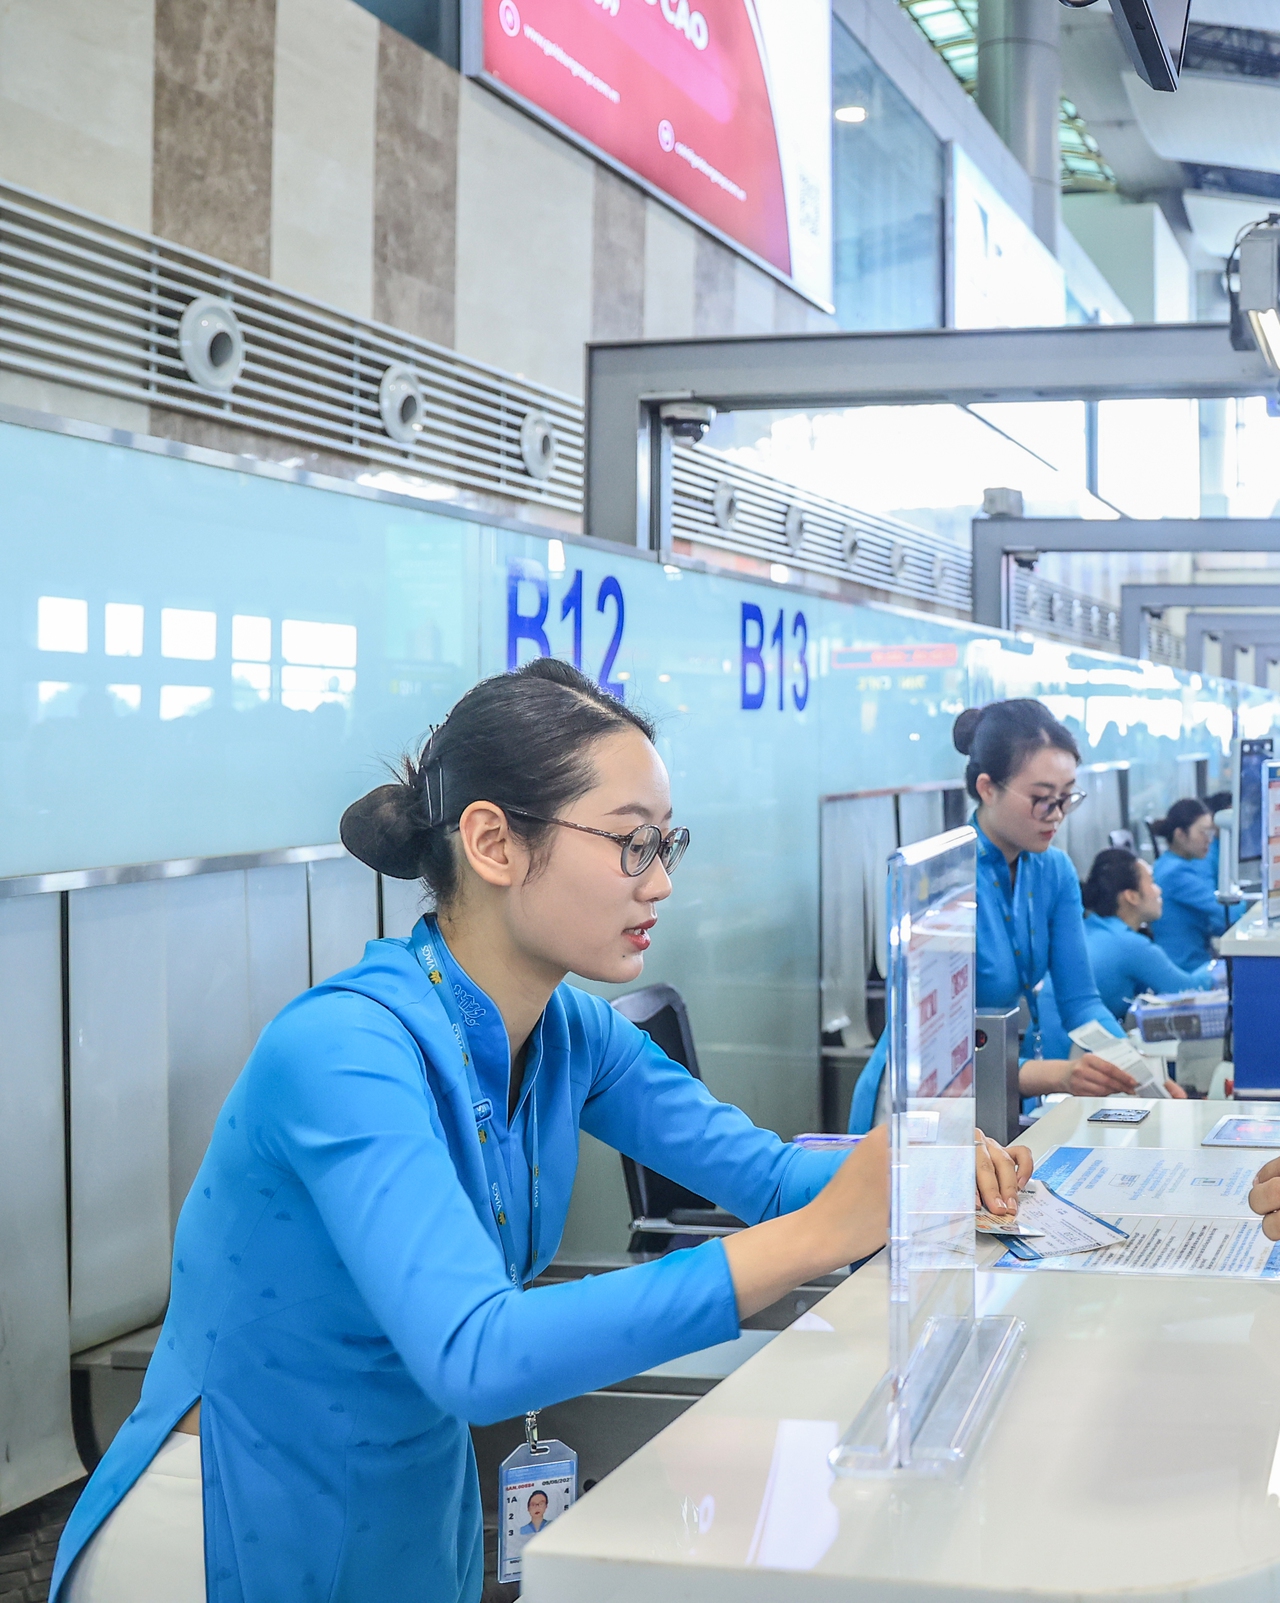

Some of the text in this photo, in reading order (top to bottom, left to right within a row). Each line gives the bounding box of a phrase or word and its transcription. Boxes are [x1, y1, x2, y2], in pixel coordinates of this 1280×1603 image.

[506, 558, 625, 705] B12
[741, 601, 809, 712] B13
[421, 945, 436, 970] VIAGS
[491, 1182, 502, 1211] VIAGS
[506, 1496, 518, 1504] 1A
